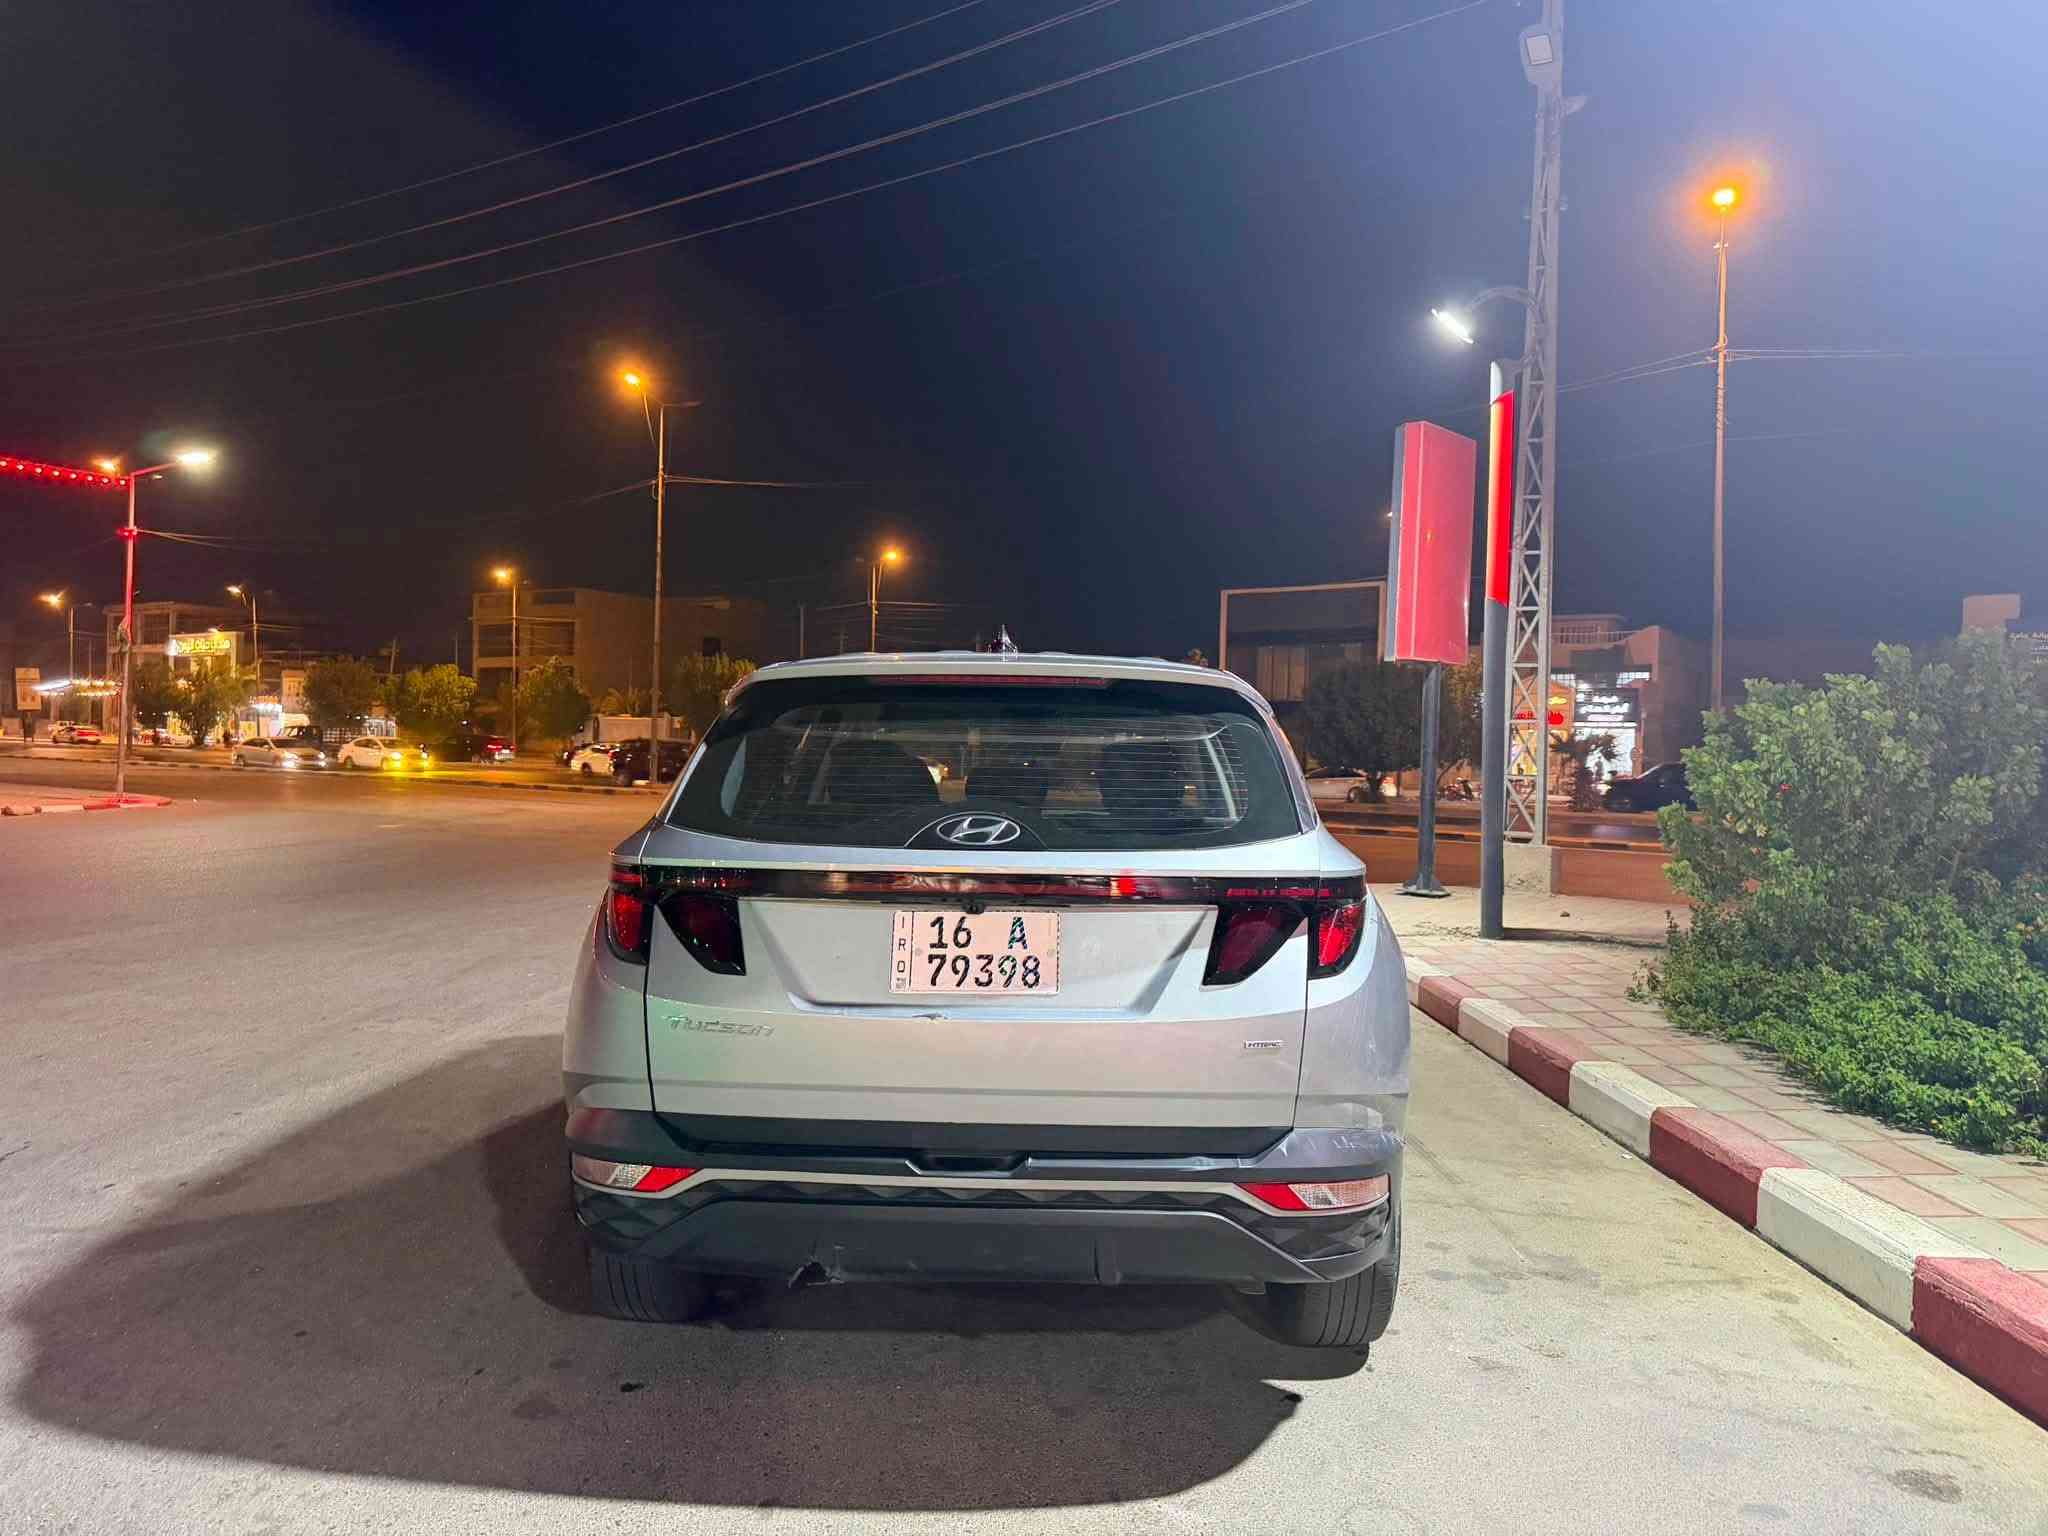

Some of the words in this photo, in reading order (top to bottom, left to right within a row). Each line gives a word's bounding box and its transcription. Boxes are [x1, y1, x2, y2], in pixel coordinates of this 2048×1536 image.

[929, 916, 972, 949] 16
[1008, 916, 1028, 949] A
[928, 954, 1041, 988] 79398
